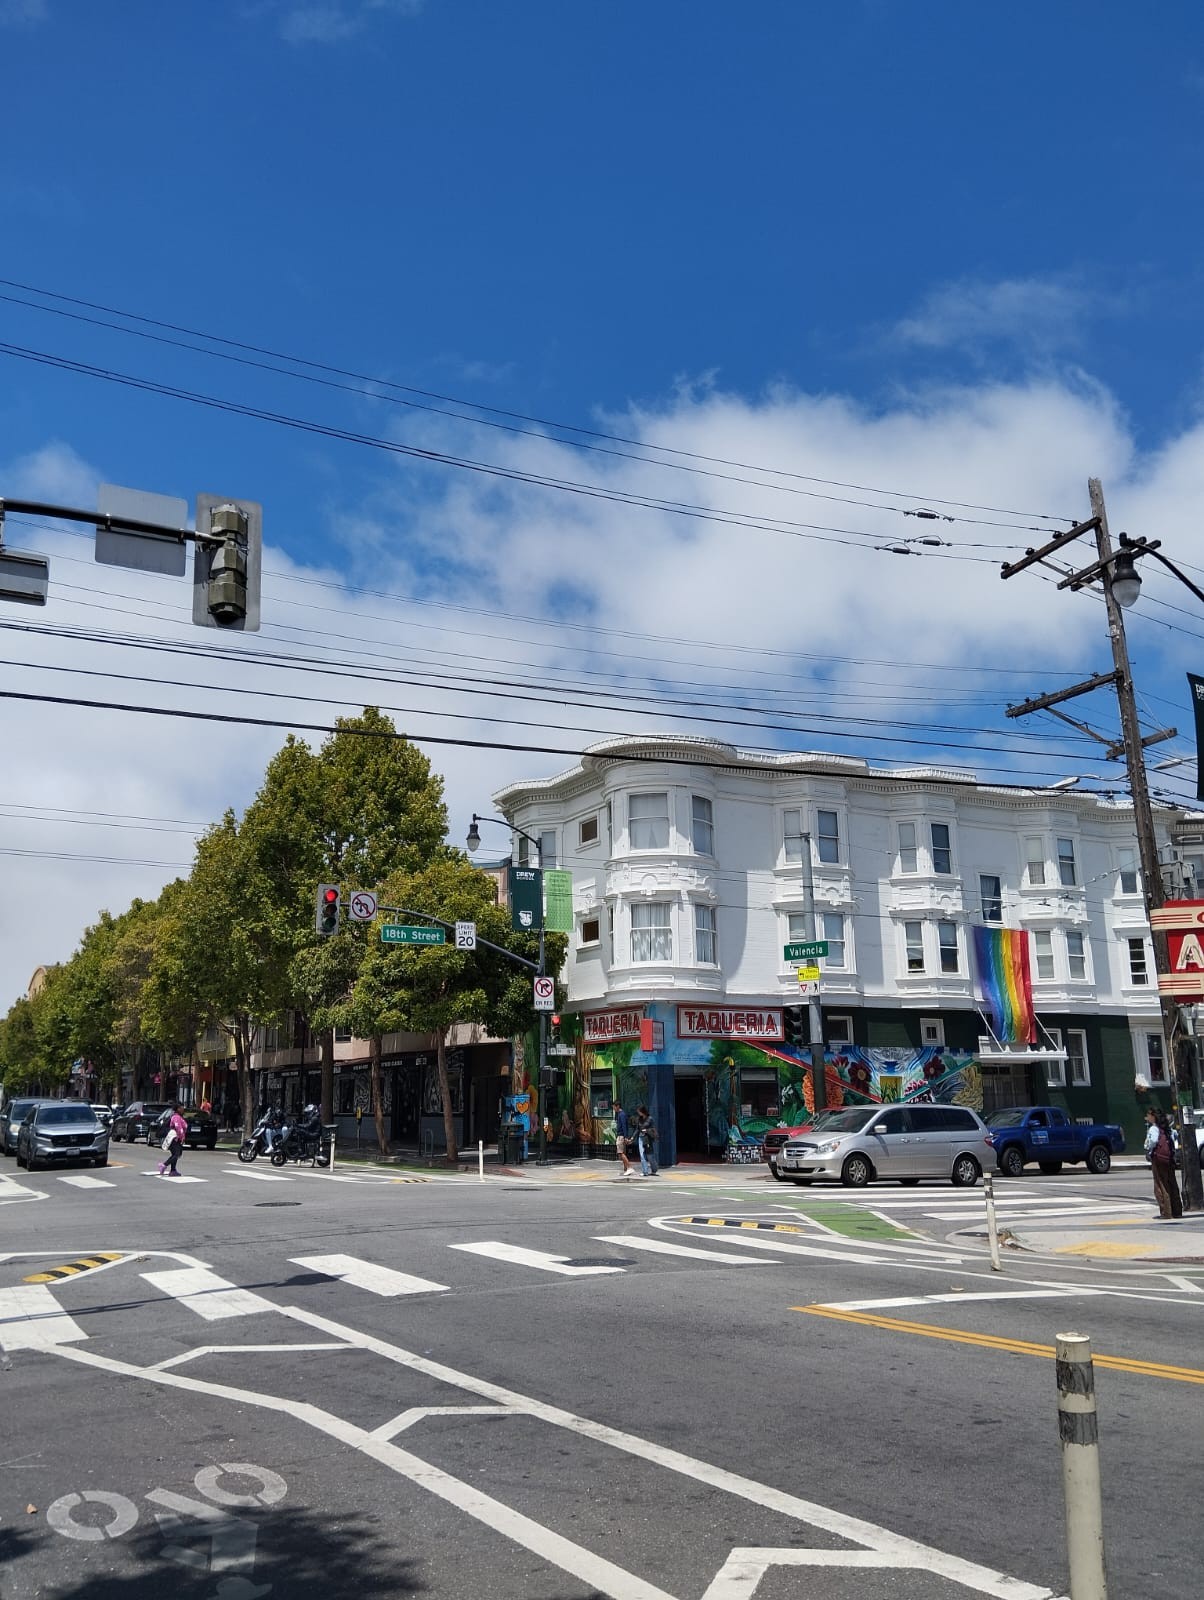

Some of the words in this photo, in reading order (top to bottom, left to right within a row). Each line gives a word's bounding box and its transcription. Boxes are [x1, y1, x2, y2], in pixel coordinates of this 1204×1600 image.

[385, 929, 407, 939] 18th
[411, 931, 441, 940] Street
[458, 936, 474, 946] 20
[790, 946, 823, 956] Valencia
[586, 1012, 641, 1037] TAQUERIA
[684, 1011, 779, 1034] TAQUERIA
